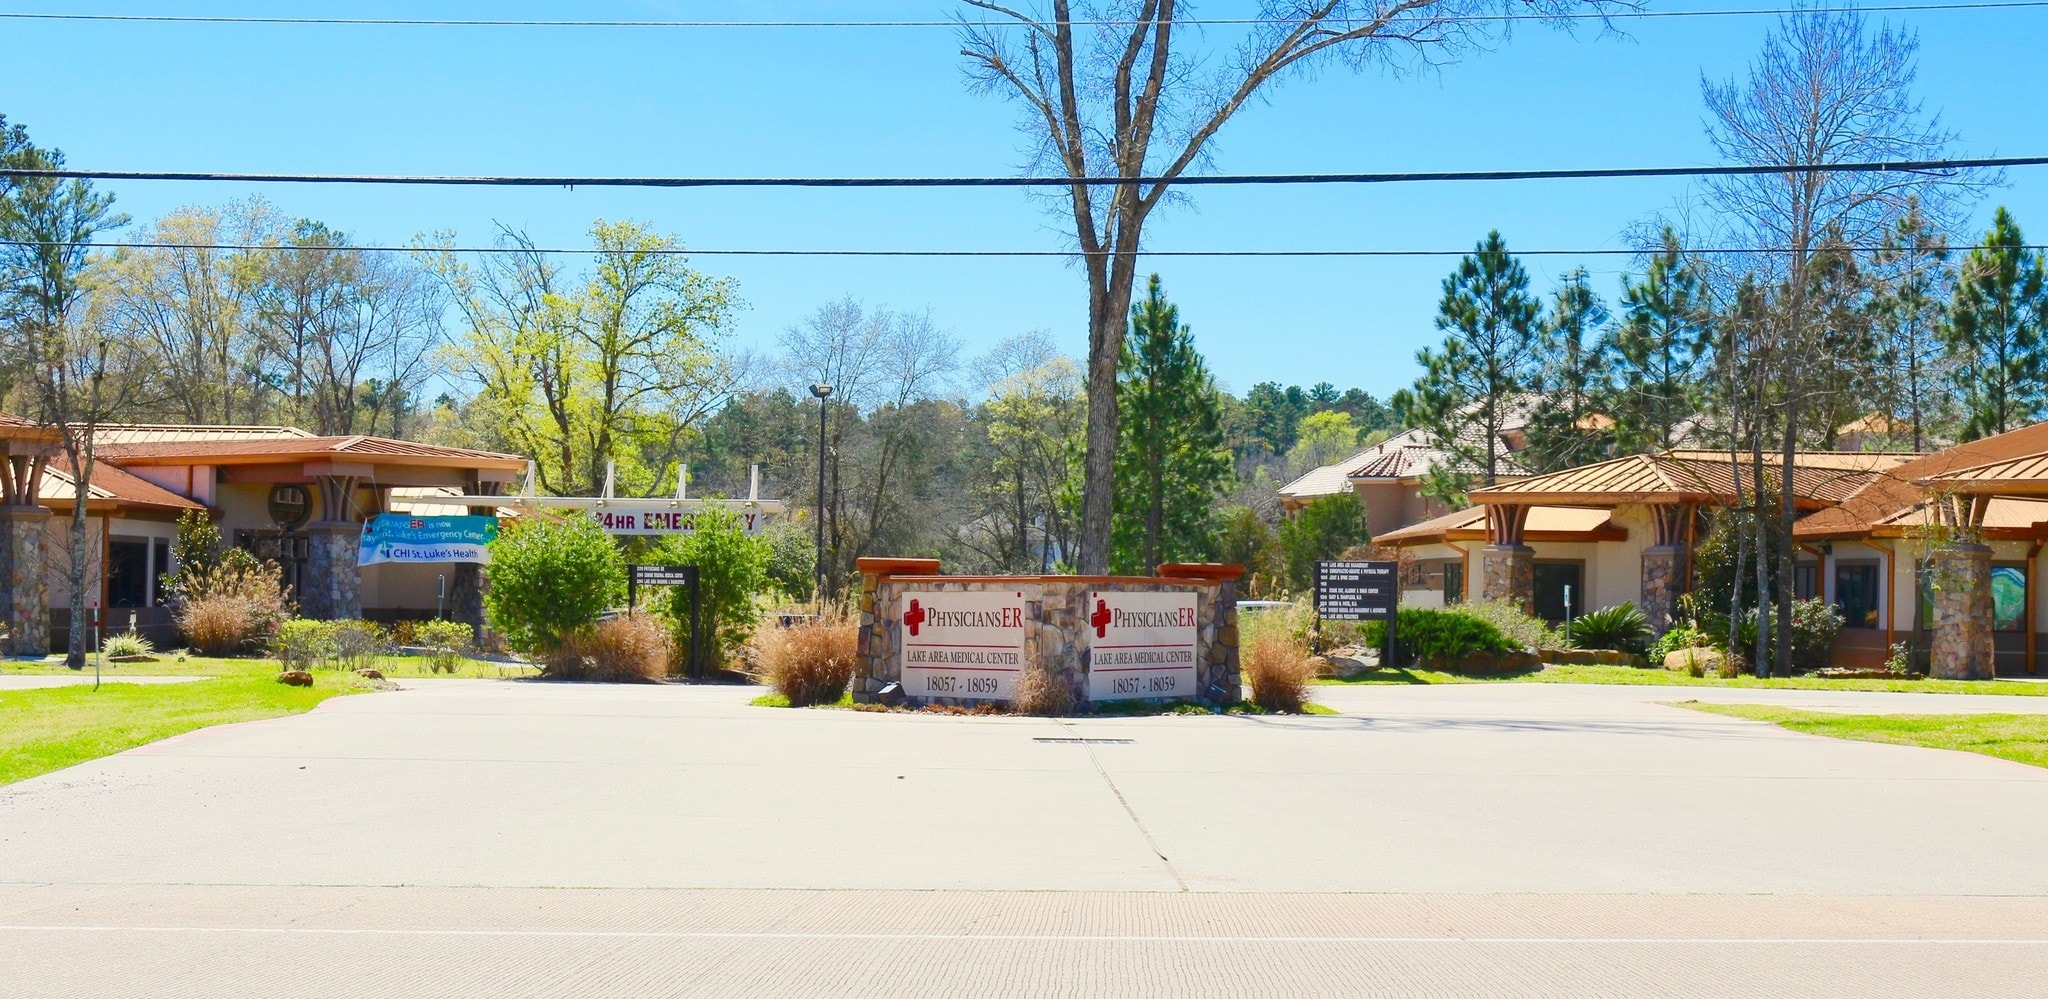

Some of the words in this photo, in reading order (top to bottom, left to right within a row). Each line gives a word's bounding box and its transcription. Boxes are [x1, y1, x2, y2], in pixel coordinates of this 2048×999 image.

[643, 512, 757, 530] EMERY
[418, 530, 462, 540] Emergency
[394, 549, 410, 558] CHI
[412, 550, 423, 559] St.
[424, 549, 451, 558] Luke's
[454, 550, 478, 558] Health
[927, 607, 1023, 628] PHYSICIANSER
[1114, 608, 1196, 628] PHYSICIANSER
[907, 650, 926, 662] LAKE
[928, 651, 949, 663] AREA
[951, 651, 985, 664] MEDICAL
[987, 652, 1019, 664] CENTER
[1094, 653, 1112, 665] LAKE
[1114, 652, 1133, 665] AREA
[1135, 652, 1165, 664] MEDICAL
[1166, 651, 1192, 663] CENTER
[926, 676, 956, 692] 18057
[967, 678, 998, 693] 18059
[1113, 678, 1139, 693] 18057
[1149, 676, 1175, 692] 18059
